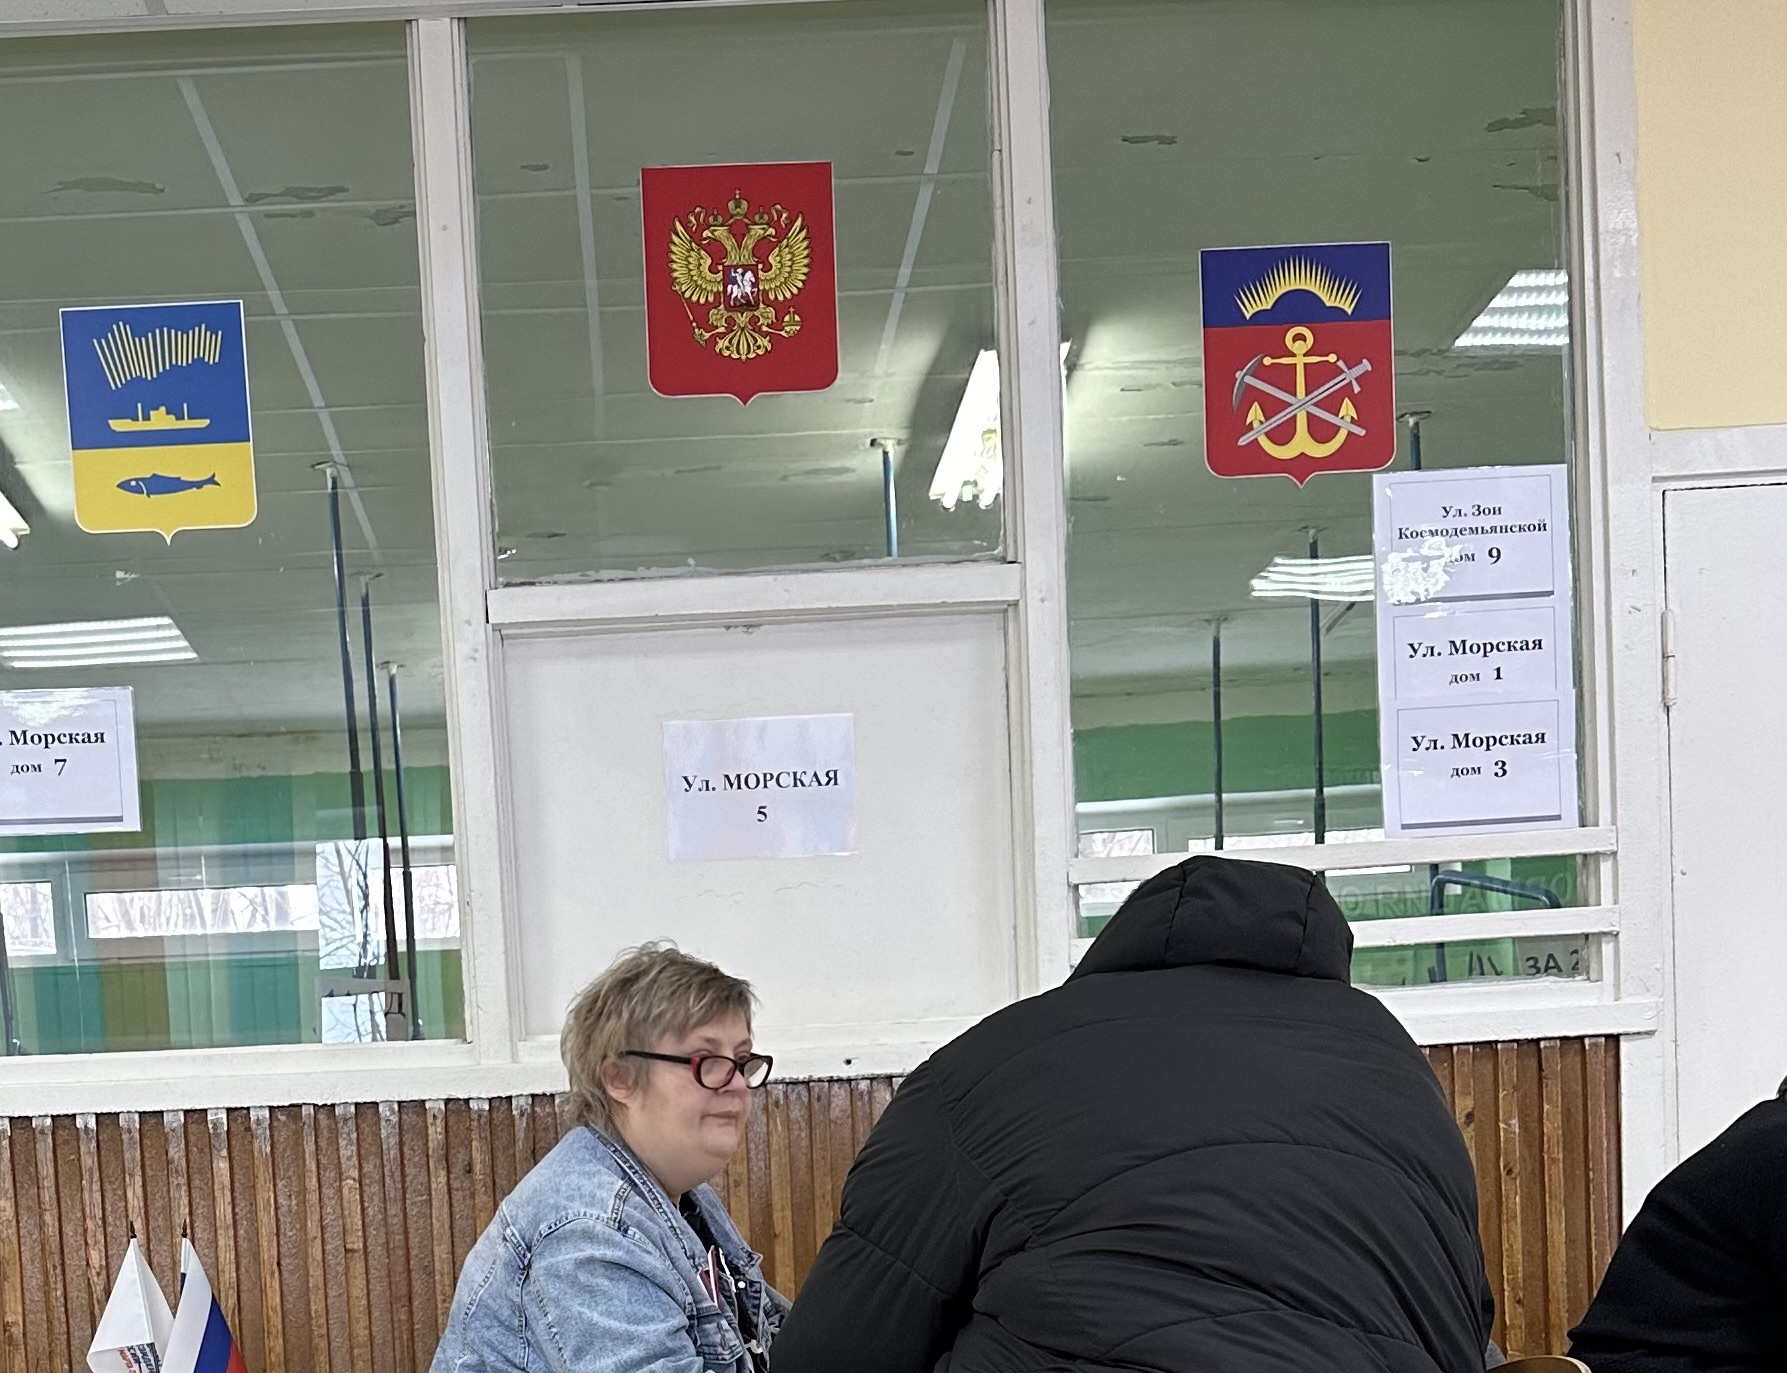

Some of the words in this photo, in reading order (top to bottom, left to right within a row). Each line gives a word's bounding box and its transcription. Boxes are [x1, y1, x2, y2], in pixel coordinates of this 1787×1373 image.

[1441, 505, 1468, 519] Ул.
[1397, 518, 1548, 540] Космодемьянской
[1448, 552, 1476, 566] ом
[1487, 546, 1502, 566] 9
[1407, 642, 1442, 659] Ул.
[1448, 638, 1543, 658] Морская
[1449, 672, 1481, 686] дом
[1493, 666, 1503, 681] 1
[8, 729, 106, 749] Морская
[1410, 735, 1445, 752] Ул.
[1450, 731, 1547, 752] Морская
[10, 763, 43, 775] дом
[54, 758, 68, 776] 7
[1450, 766, 1482, 779] дом
[1493, 759, 1508, 778] 3
[681, 775, 716, 792] Ул.
[722, 769, 839, 791] МОРСКАЯ
[756, 805, 768, 822] 5
